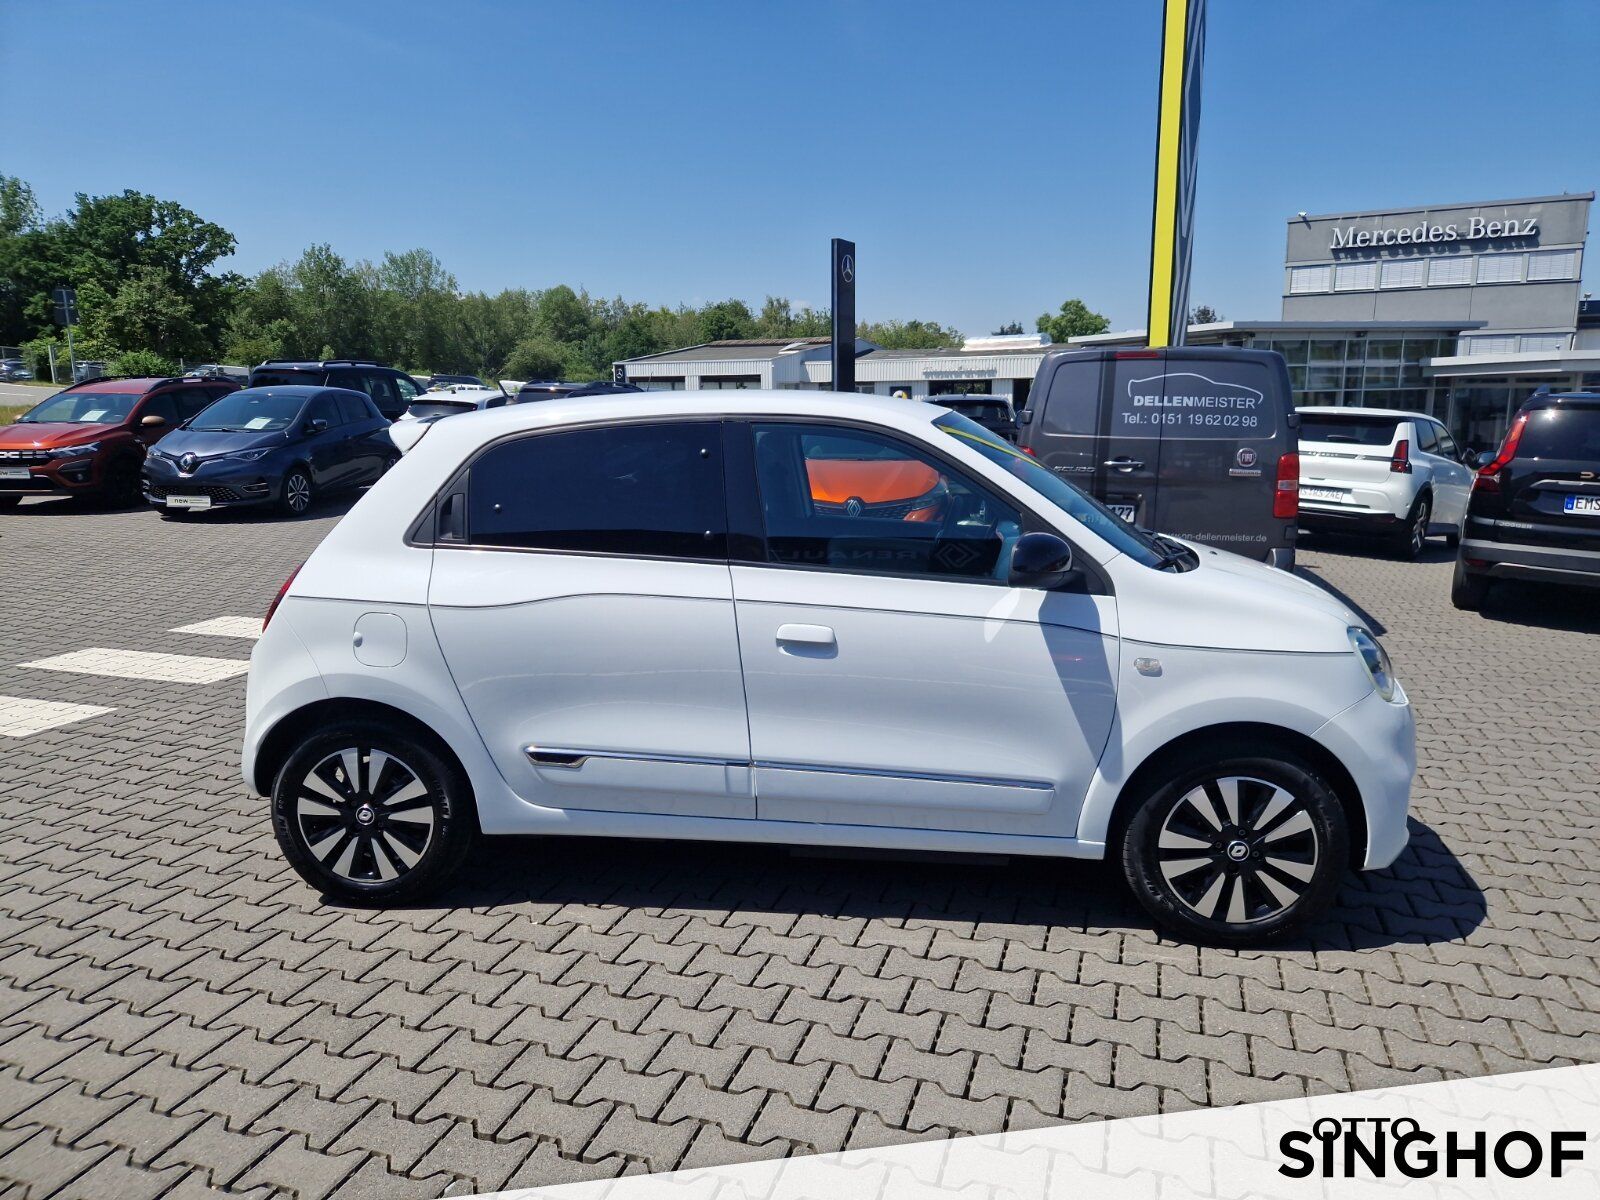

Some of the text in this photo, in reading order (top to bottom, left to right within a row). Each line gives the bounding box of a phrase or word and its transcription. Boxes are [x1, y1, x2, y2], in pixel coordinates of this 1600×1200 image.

[1329, 216, 1538, 250] Mercedes Benz
[1133, 395, 1256, 409] DELLENMEISTER
[1121, 412, 1147, 424] Tel.:
[1151, 413, 1182, 424] 0151
